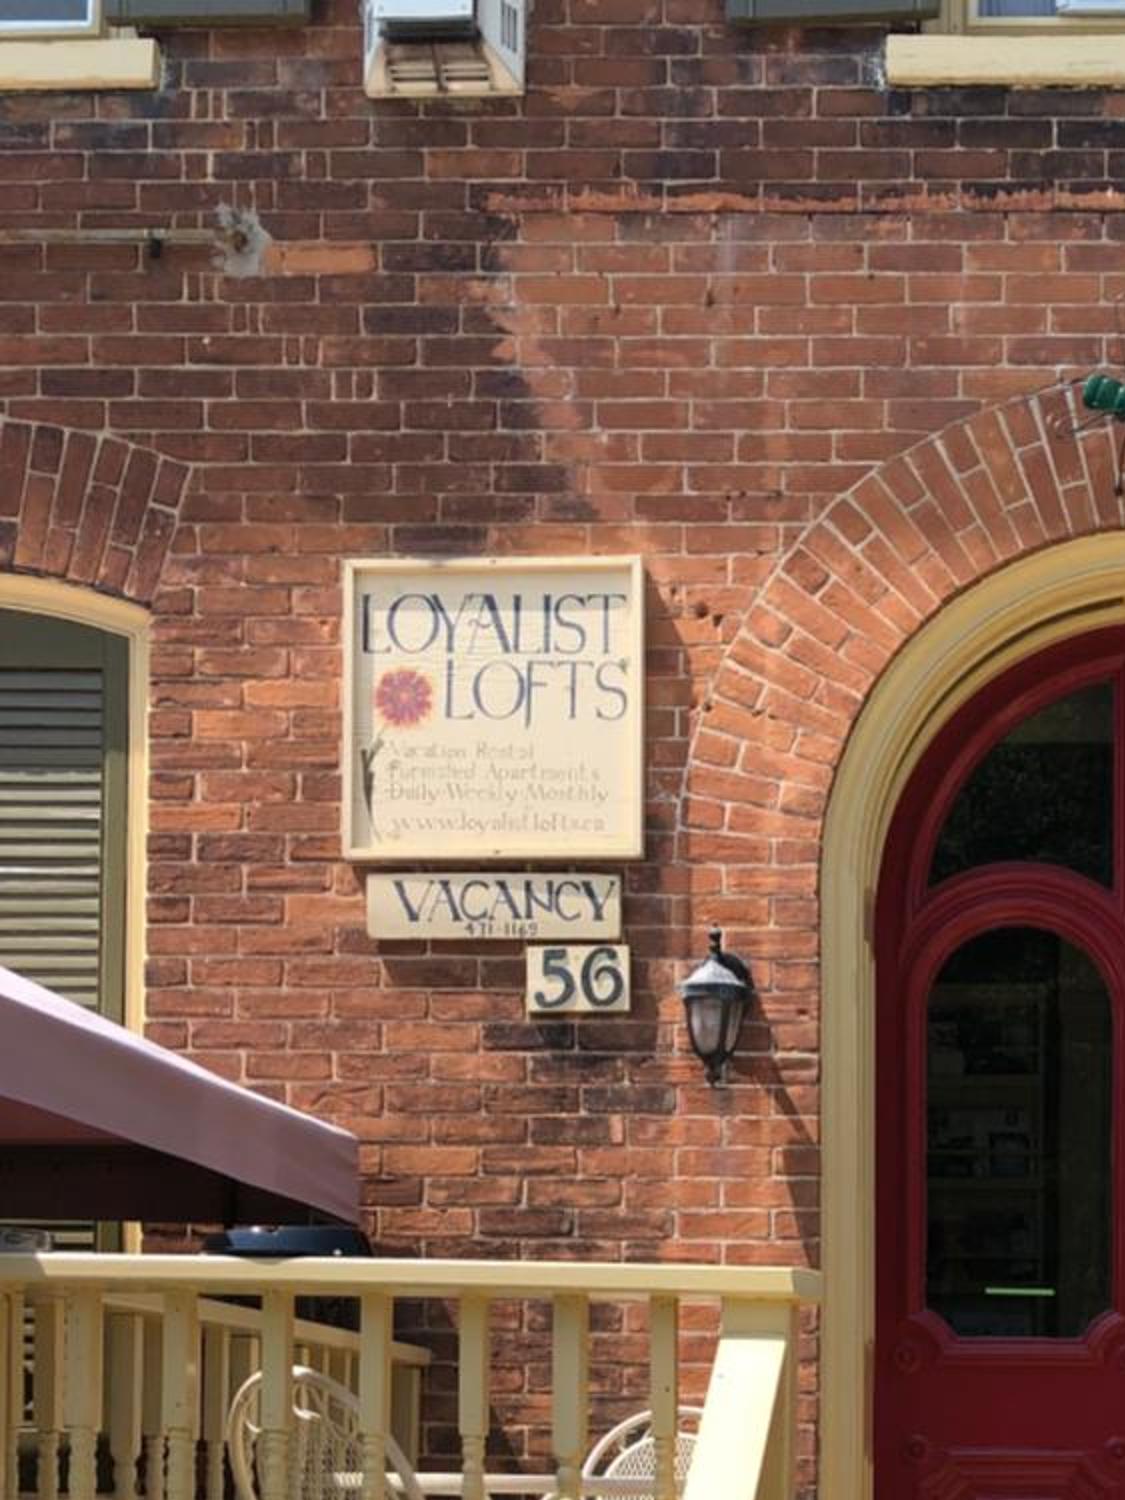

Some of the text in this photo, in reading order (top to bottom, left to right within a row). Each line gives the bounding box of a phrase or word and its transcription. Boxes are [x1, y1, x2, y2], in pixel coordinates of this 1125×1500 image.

[361, 592, 627, 655] LOYALIST
[444, 659, 628, 729] LOFTS
[393, 879, 616, 922] VACANCY
[533, 947, 624, 1009] 56
